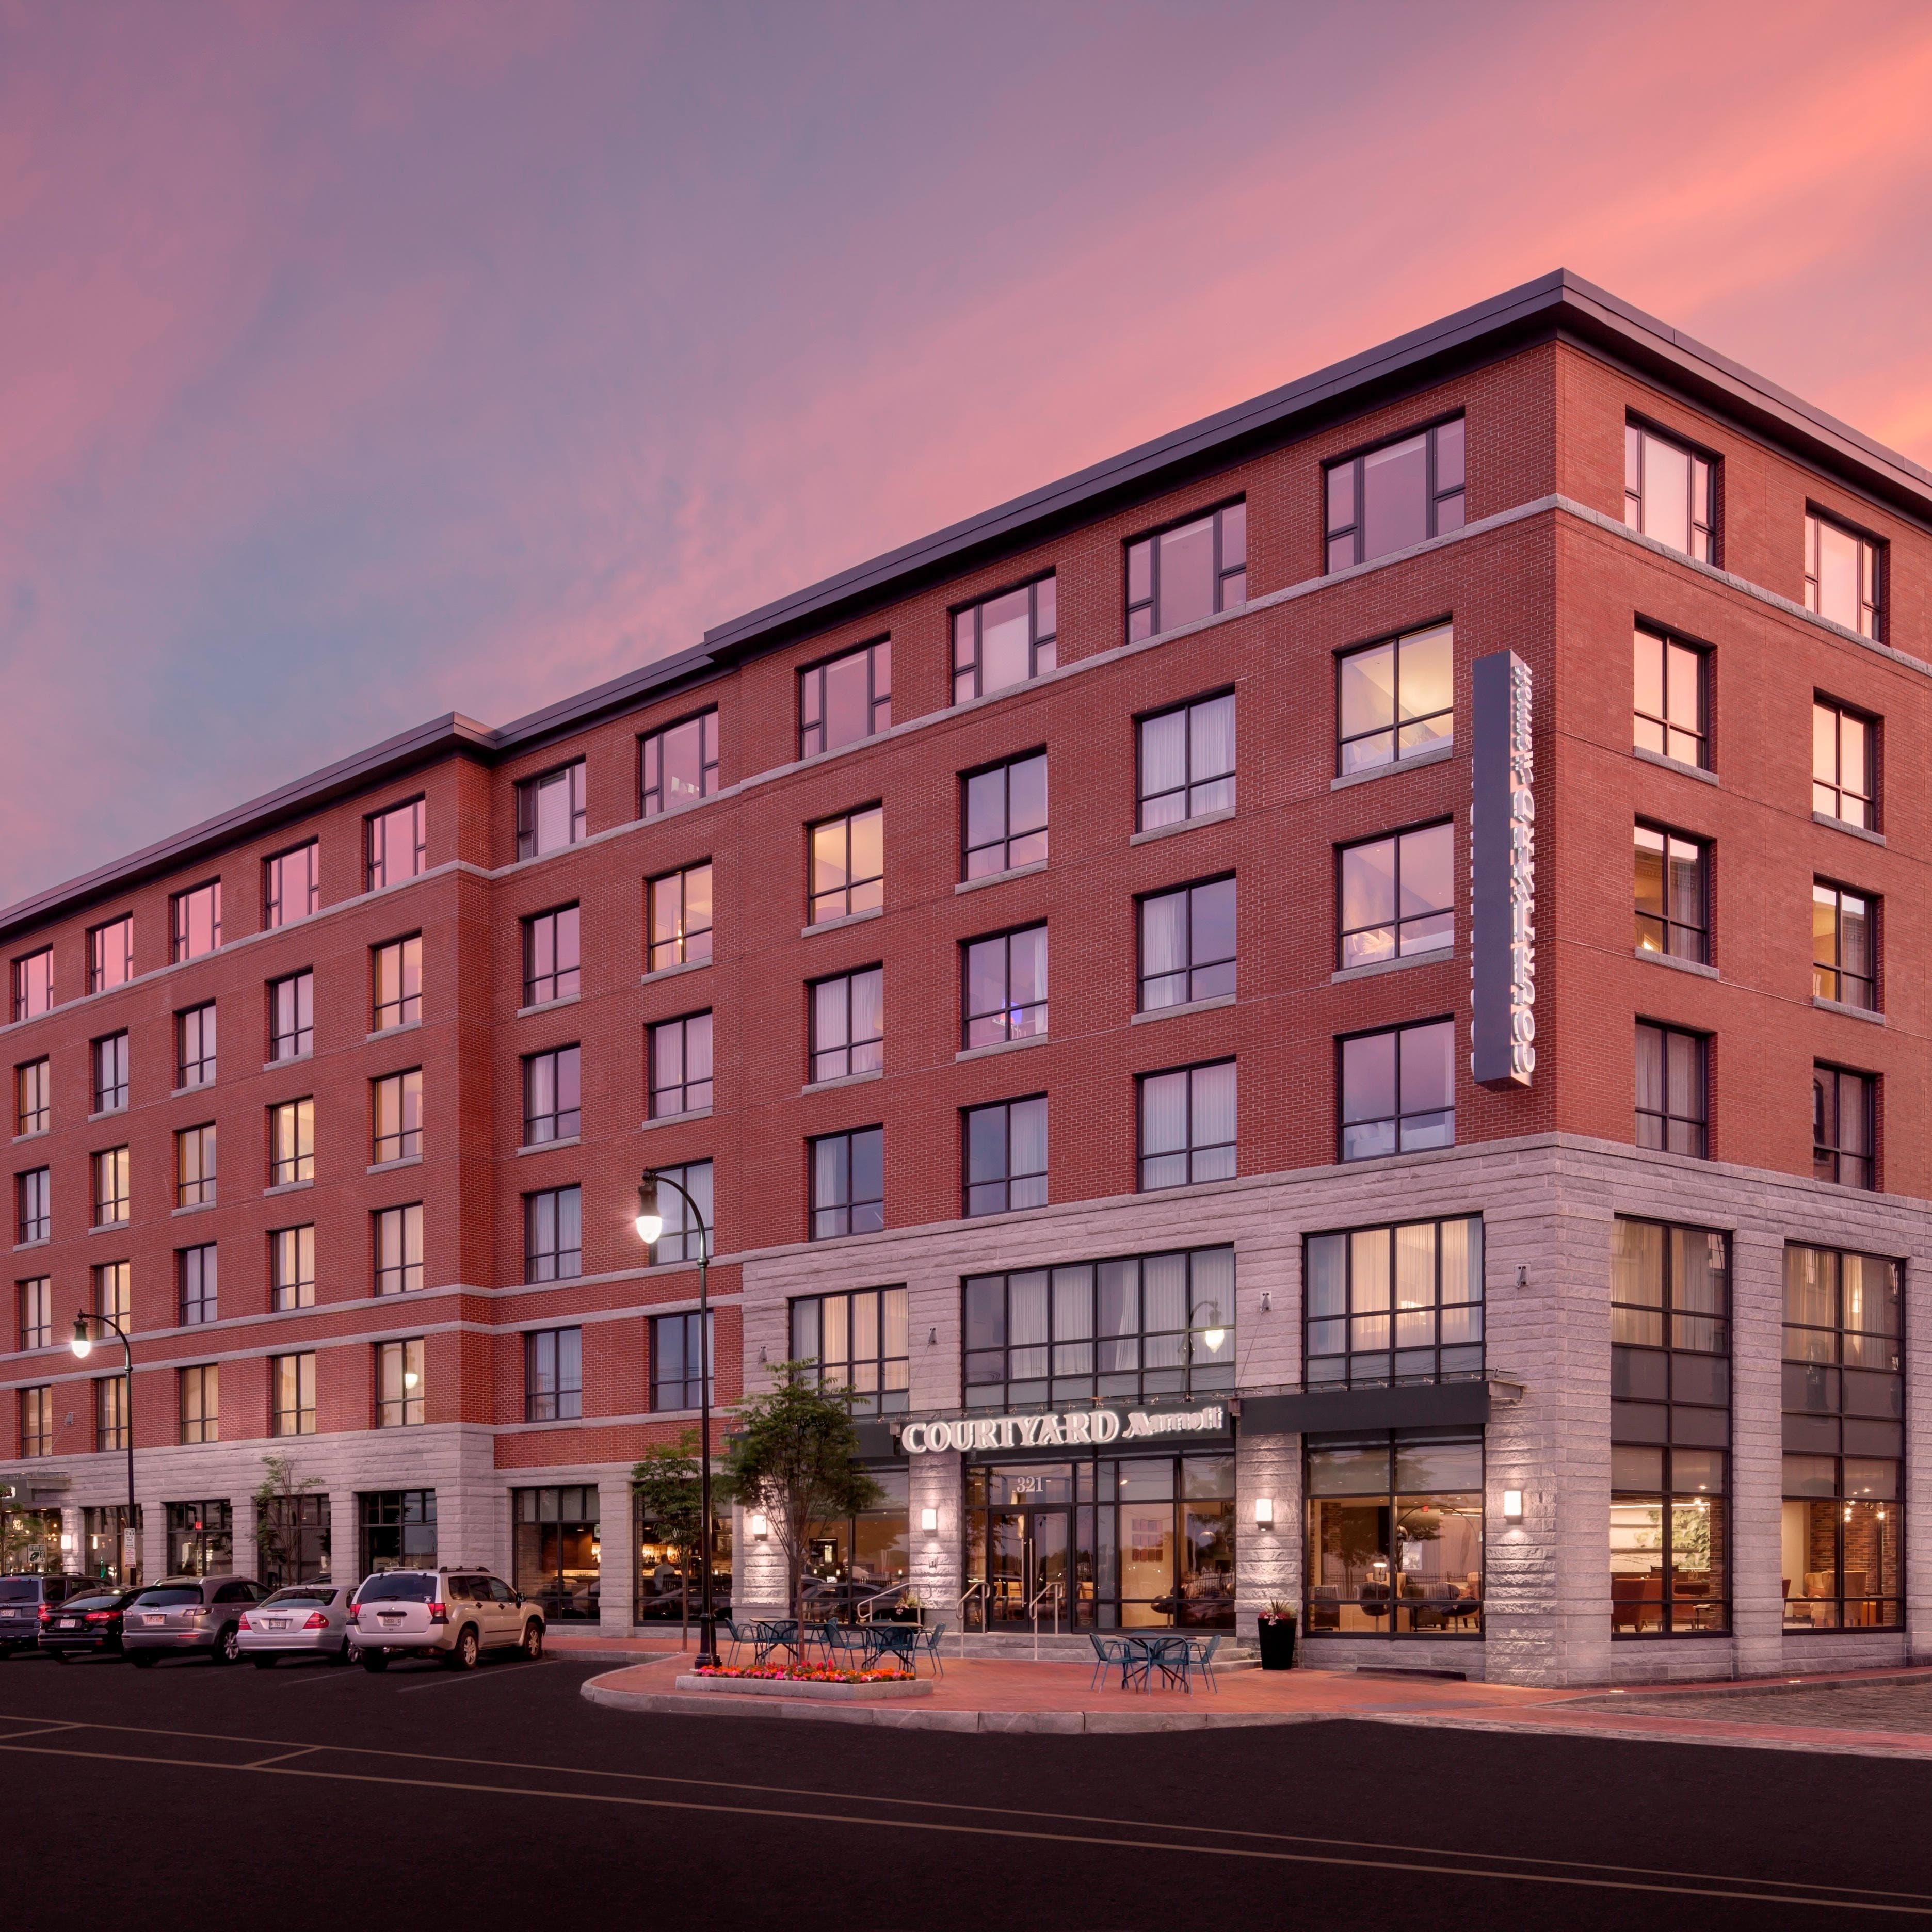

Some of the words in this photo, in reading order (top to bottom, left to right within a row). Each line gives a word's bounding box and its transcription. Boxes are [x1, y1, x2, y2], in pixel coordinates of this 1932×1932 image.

[1515, 788, 1535, 1074] COURTYARD
[902, 1411, 1119, 1453] COURTYARD
[1017, 1476, 1043, 1492] 321
